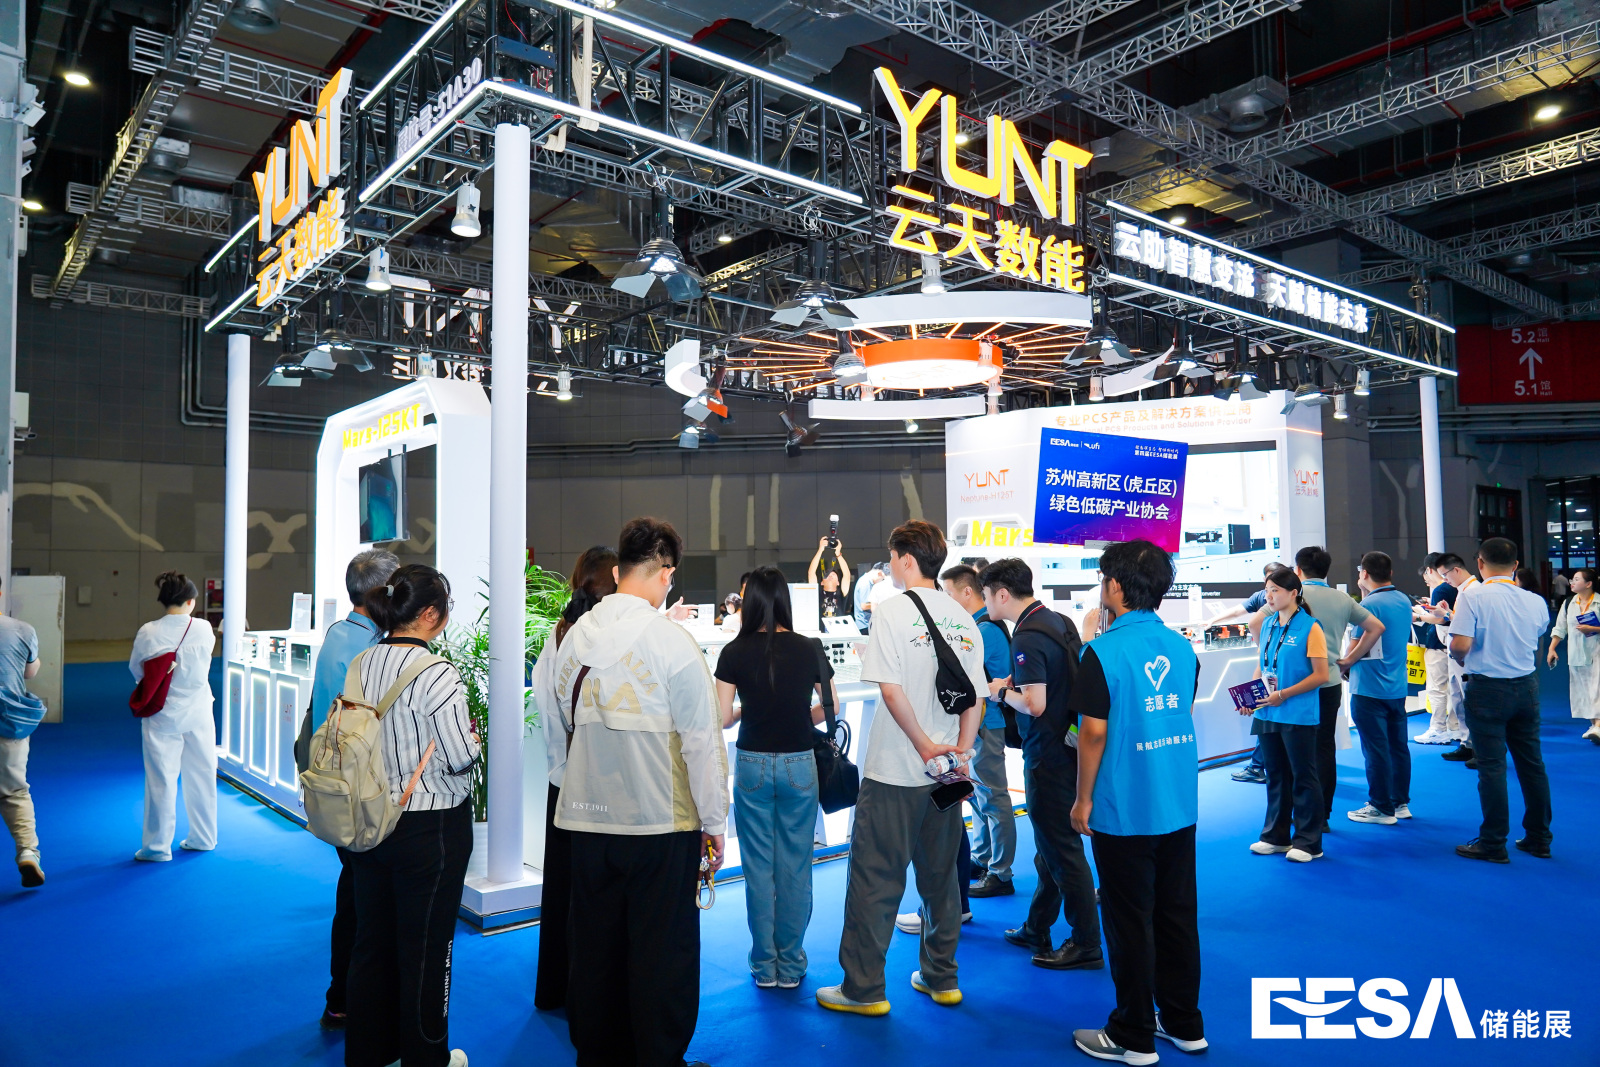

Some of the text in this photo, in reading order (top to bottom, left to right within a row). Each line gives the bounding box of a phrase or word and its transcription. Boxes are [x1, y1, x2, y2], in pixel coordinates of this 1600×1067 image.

[252, 67, 353, 242] YUNT
[874, 67, 1094, 226] YUNT
[256, 187, 345, 306] 云天数能
[886, 184, 1085, 293] 云天数能
[1114, 221, 1255, 298] 云助智慧变流
[1511, 328, 1535, 343] 5.2
[1514, 380, 1538, 396] 5.1
[343, 403, 421, 451] Mars-125KT
[1105, 424, 1121, 433] PCS
[1160, 420, 1176, 430] and
[1217, 417, 1252, 427] Provider
[964, 469, 1010, 489] YUNT
[1293, 469, 1319, 485] YUNT
[1049, 494, 1170, 520] 绿色低碳产业协会
[1144, 693, 1179, 712] 志愿者
[572, 801, 609, 812] EST.1911
